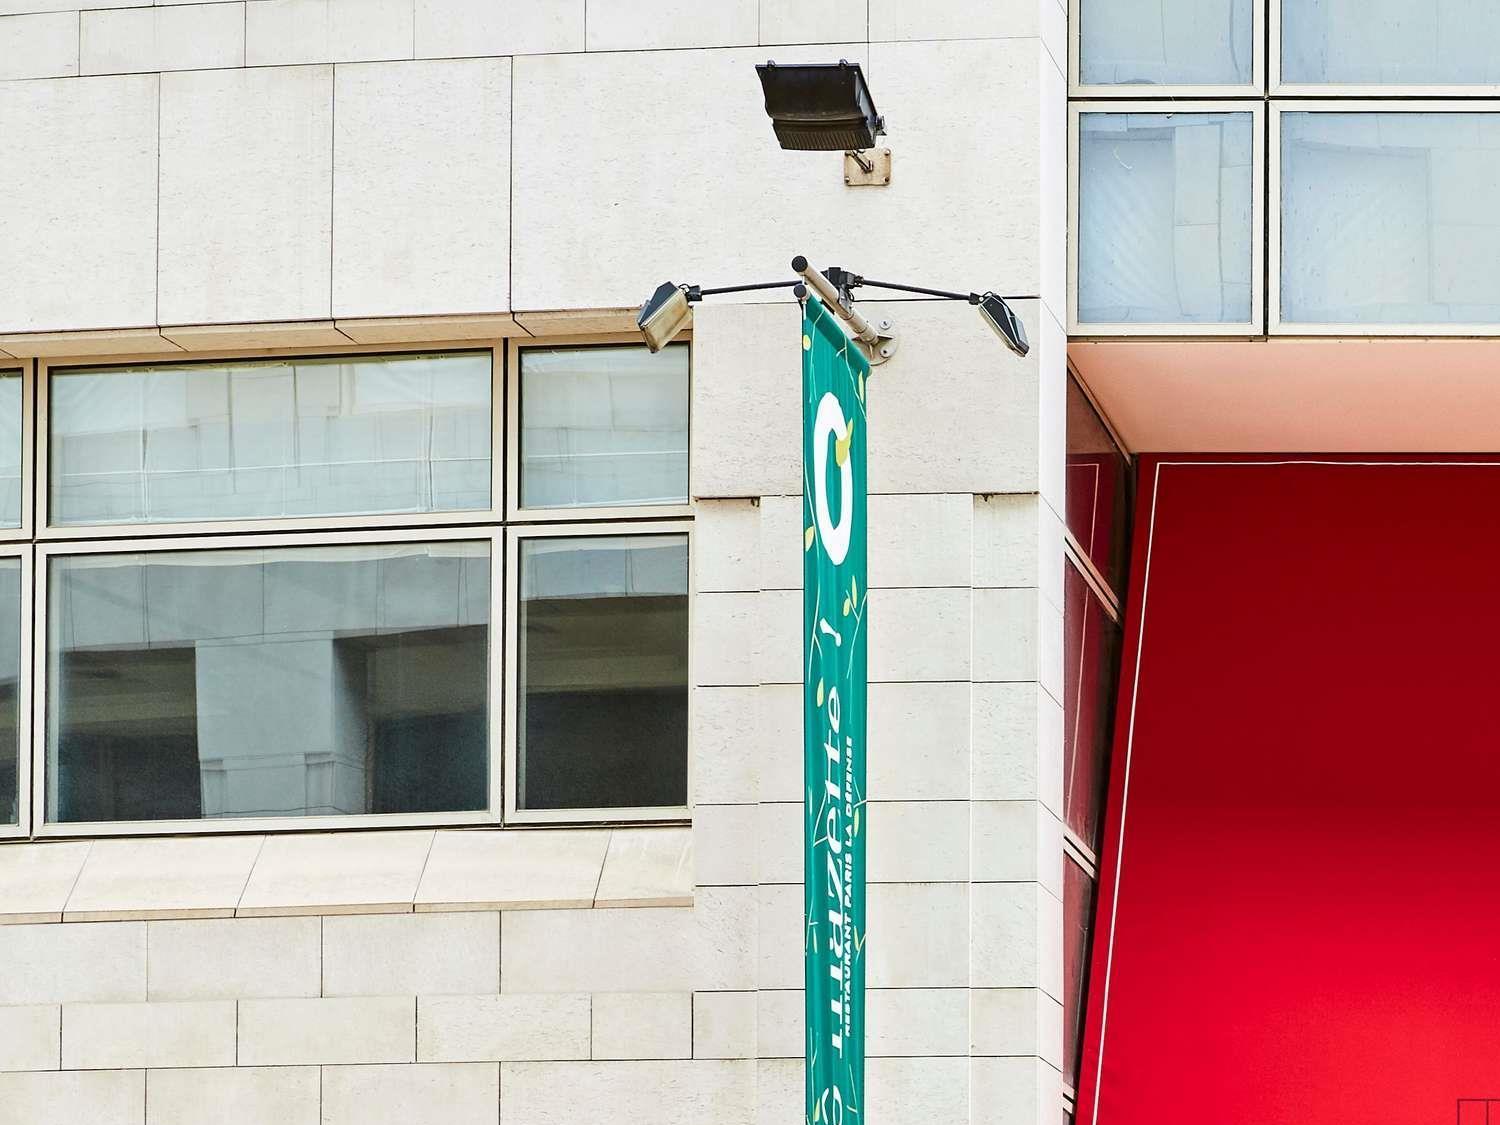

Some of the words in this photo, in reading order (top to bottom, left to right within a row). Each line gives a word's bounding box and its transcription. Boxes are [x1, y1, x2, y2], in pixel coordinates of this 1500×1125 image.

[845, 735, 853, 818] DÉFENSE
[845, 825, 852, 848] LA
[844, 853, 852, 909] PARIS
[844, 913, 852, 1038] RESTAURANT
